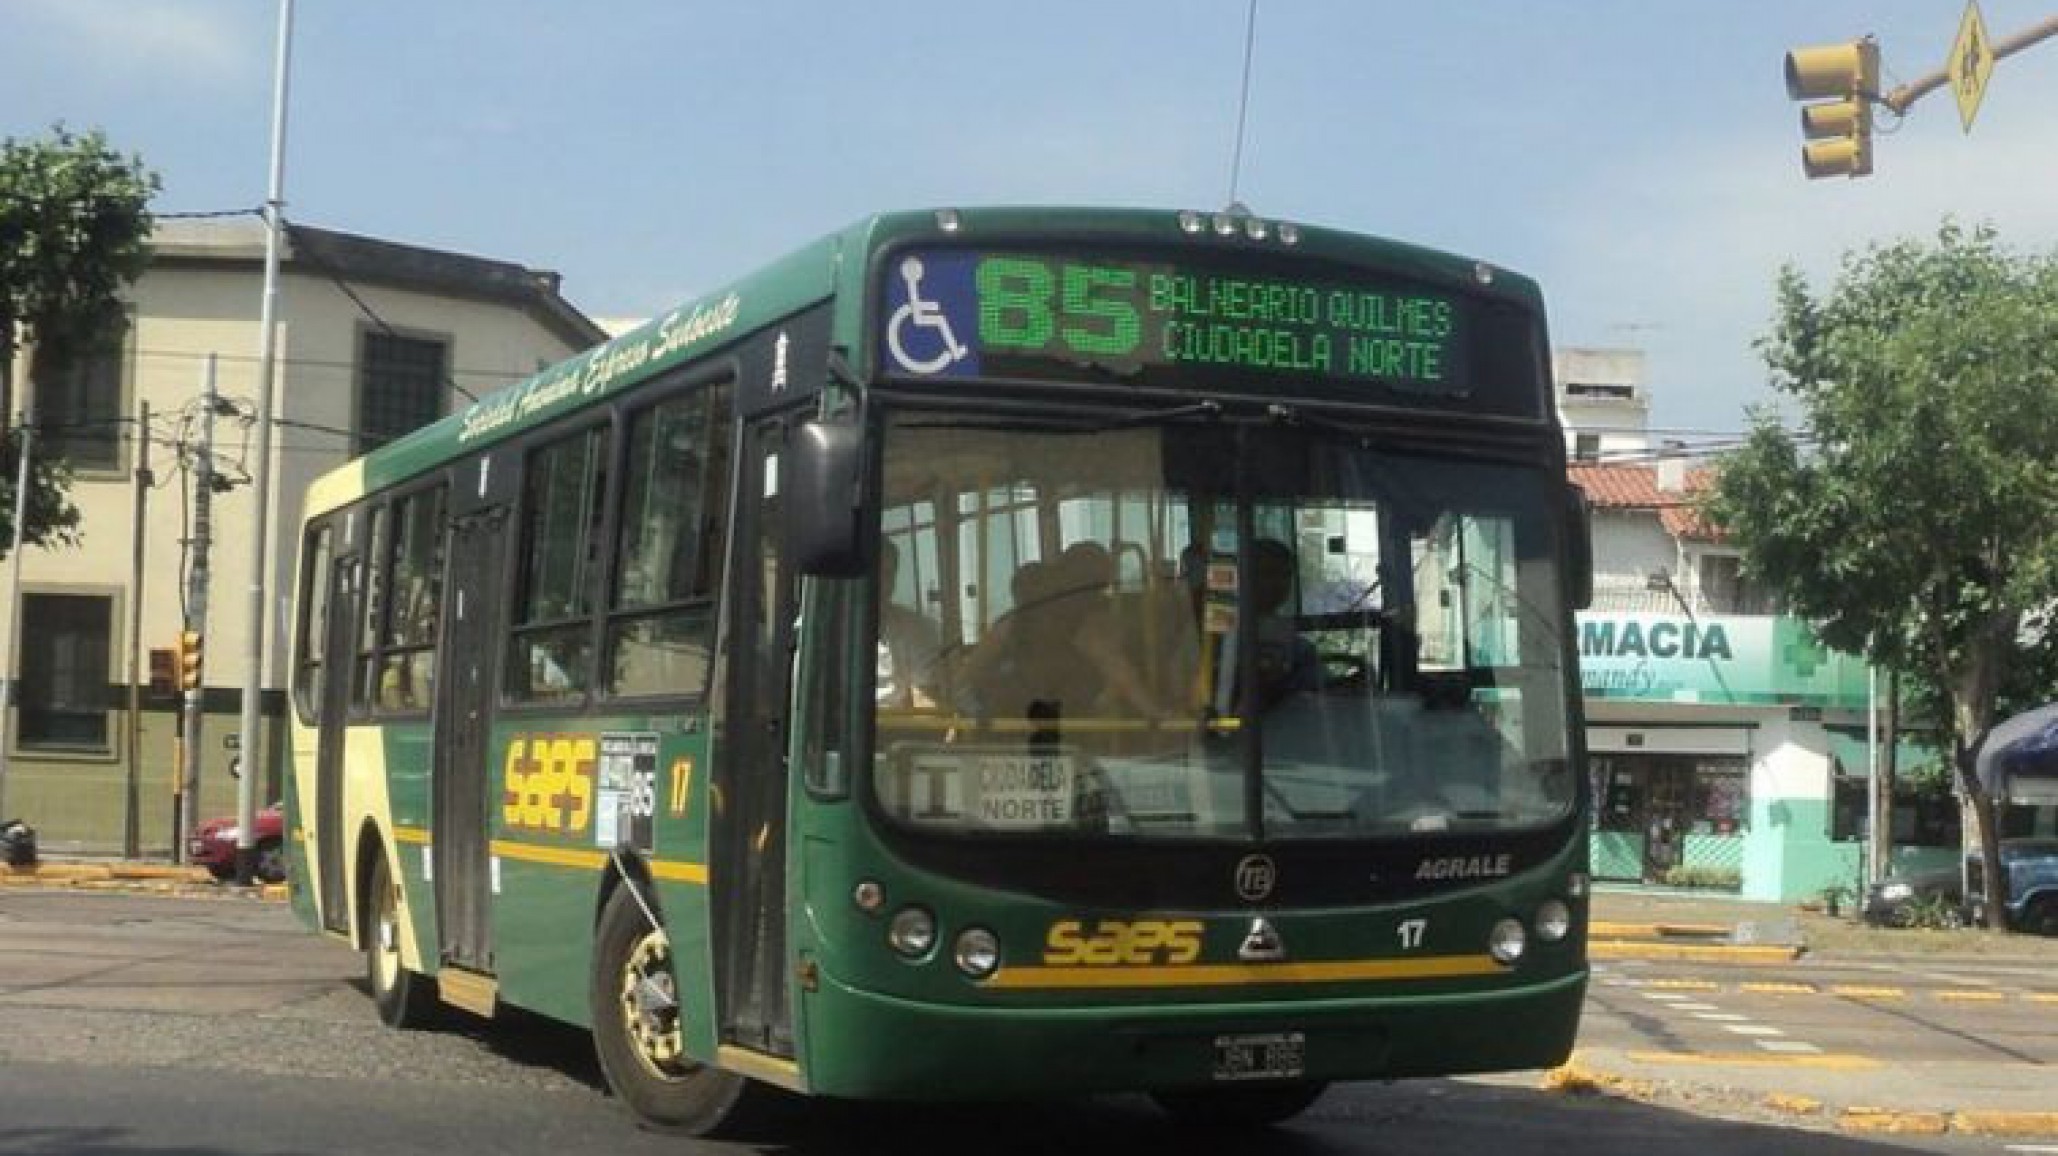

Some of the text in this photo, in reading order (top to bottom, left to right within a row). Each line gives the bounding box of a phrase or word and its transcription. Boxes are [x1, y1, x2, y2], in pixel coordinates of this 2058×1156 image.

[1150, 274, 1451, 337] BALNEARIO QUILMES
[1161, 320, 1442, 380] CIUDADELA NORTE
[669, 759, 692, 816] 17
[982, 797, 1067, 821] NORTE
[1414, 853, 1513, 880] AGRALE
[1397, 919, 1428, 950] 17
